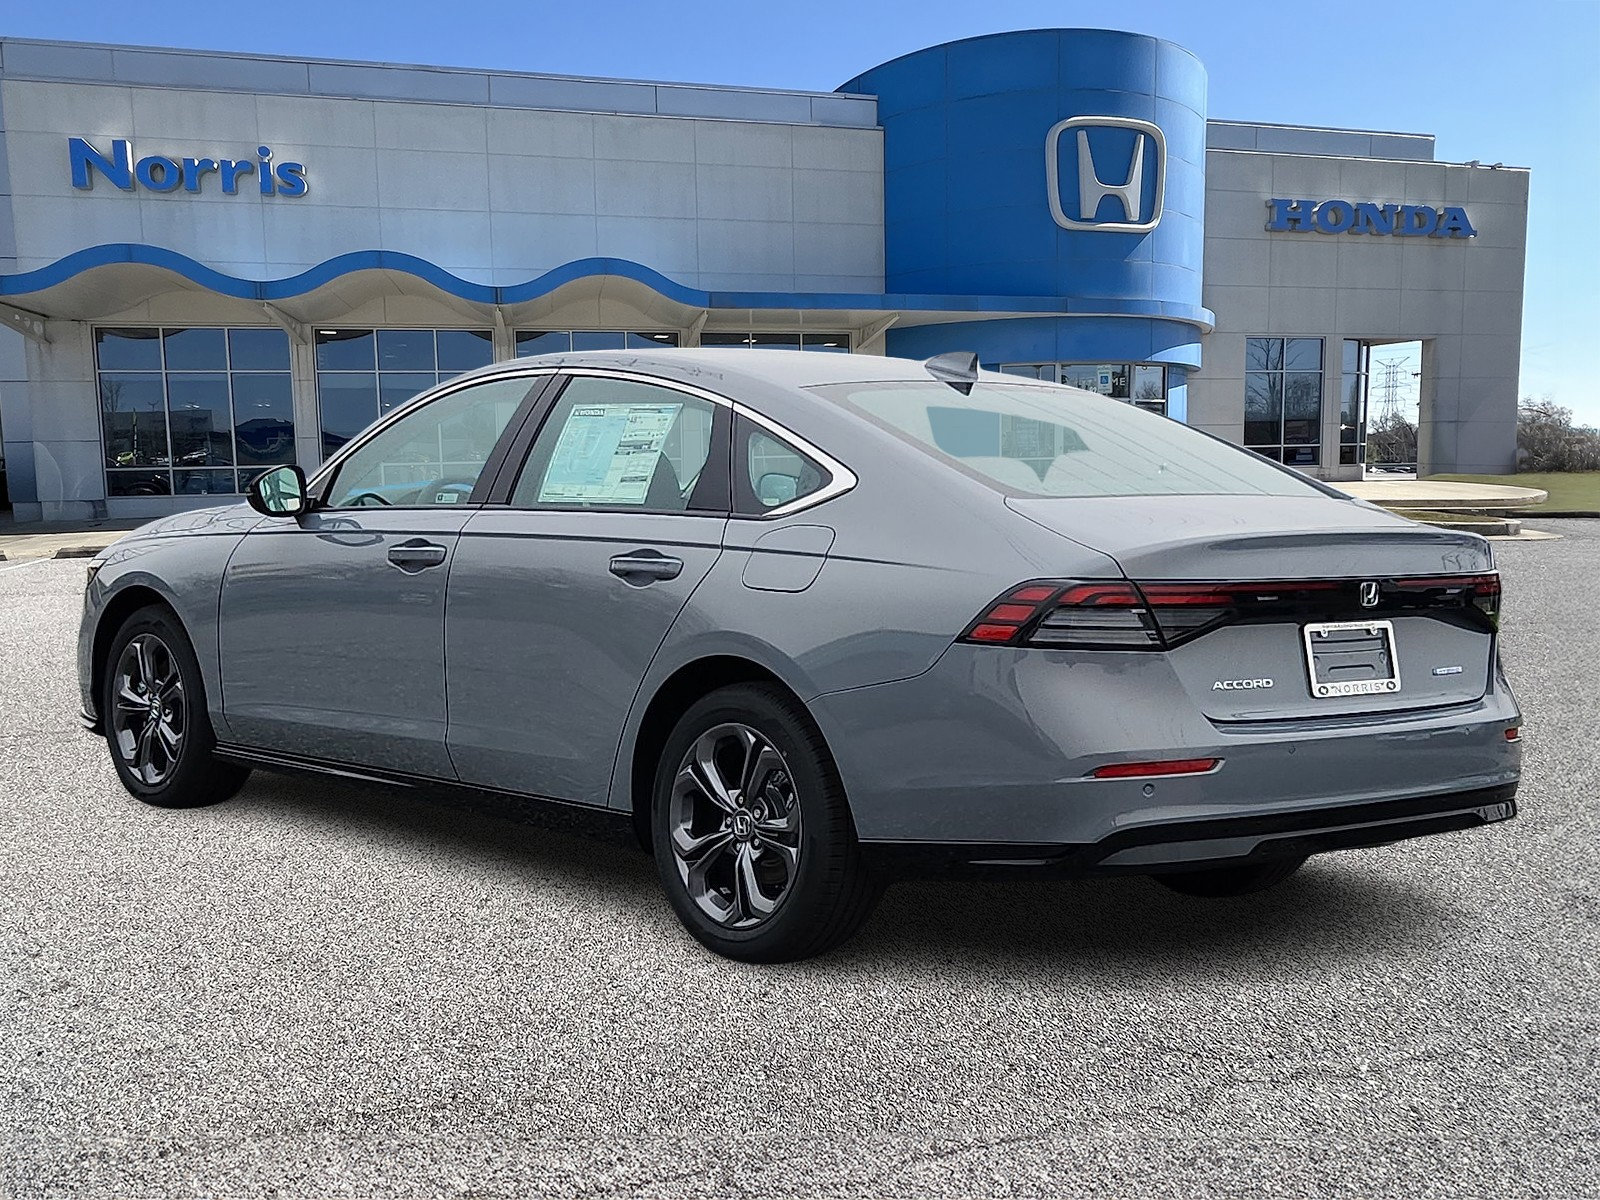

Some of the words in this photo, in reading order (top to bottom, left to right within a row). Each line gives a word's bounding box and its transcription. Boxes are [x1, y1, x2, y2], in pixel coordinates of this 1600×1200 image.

[68, 137, 308, 197] Norris
[1266, 198, 1478, 239] HONDA
[1211, 678, 1274, 691] ACCORD
[1333, 682, 1380, 694] NORRIS
